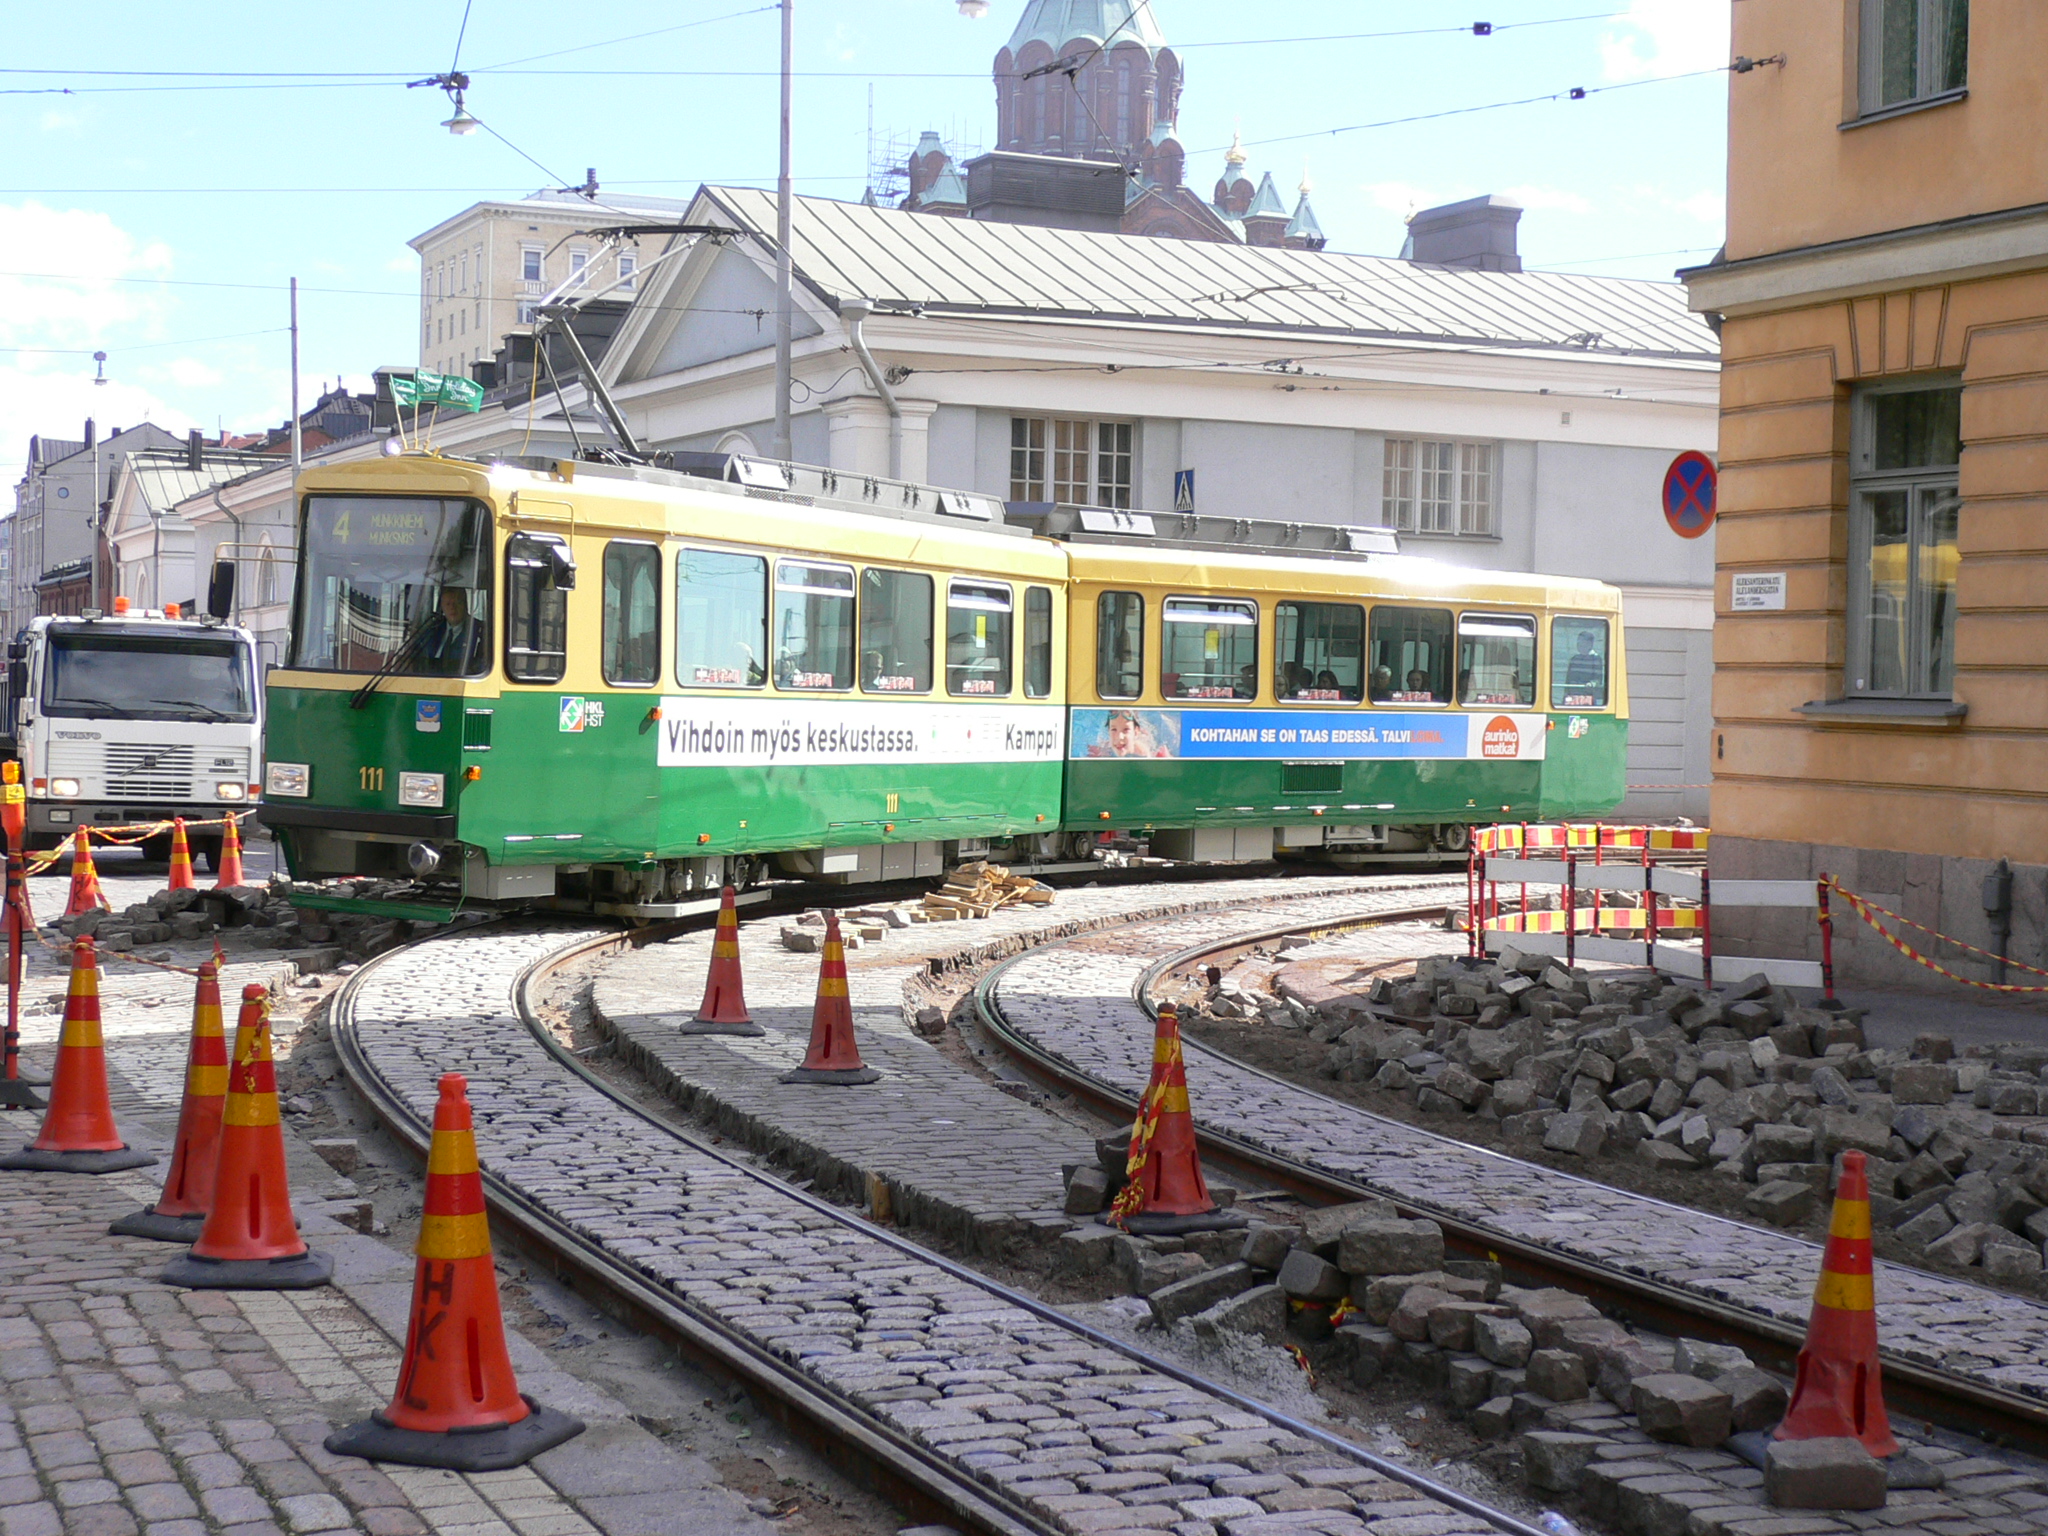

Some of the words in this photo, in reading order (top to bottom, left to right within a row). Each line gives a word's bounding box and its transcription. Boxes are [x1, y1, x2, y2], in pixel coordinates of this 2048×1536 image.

[450, 390, 469, 402] Inn
[332, 510, 350, 544] 4
[585, 700, 605, 714] HKL
[584, 714, 605, 727] HST
[54, 730, 102, 740] VOLVO
[667, 719, 745, 753] Vihdoin
[751, 719, 801, 760] myös
[806, 721, 918, 753] keskustassa.
[1005, 723, 1058, 757] Kamppi
[1190, 728, 1258, 743] KOHTAHAN
[1260, 729, 1277, 743] SE
[1279, 729, 1297, 743] ON
[1300, 729, 1329, 743] TAAS
[1331, 727, 1379, 744] EDESSÄ.
[1484, 728, 1518, 742] aurinko
[1484, 742, 1516, 755] matkat
[359, 766, 384, 791] 111
[886, 792, 899, 814] 111
[403, 1261, 455, 1411] HKL
